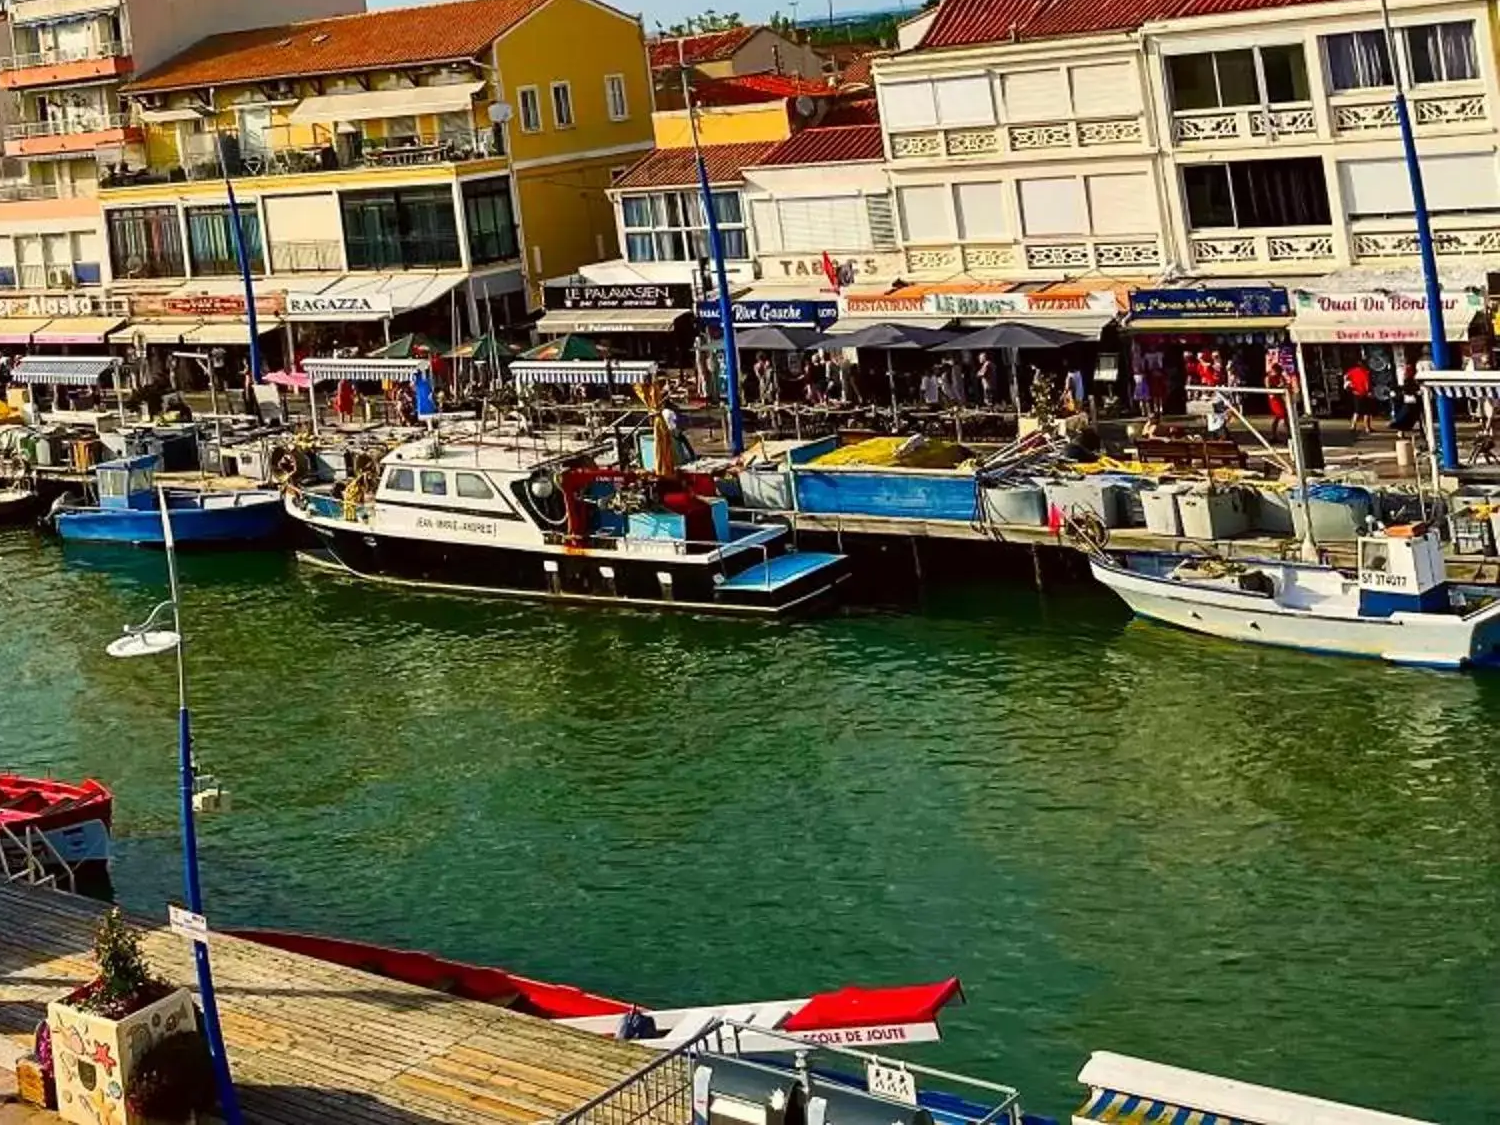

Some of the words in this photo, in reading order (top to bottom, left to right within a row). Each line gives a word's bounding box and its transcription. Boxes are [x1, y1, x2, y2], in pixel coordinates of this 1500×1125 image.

[565, 288, 581, 300] LE
[584, 286, 670, 300] PALAVASIEN
[28, 294, 93, 316] Alaska
[290, 297, 373, 312] RAGAZZA
[847, 295, 925, 312] RESTAURANT
[1027, 293, 1091, 310] PIZZERIA
[1317, 296, 1357, 311] Quai
[732, 304, 757, 321] Rive
[759, 302, 802, 321] Gauche
[845, 1031, 863, 1042] DE
[867, 1027, 906, 1041] JOUTE
